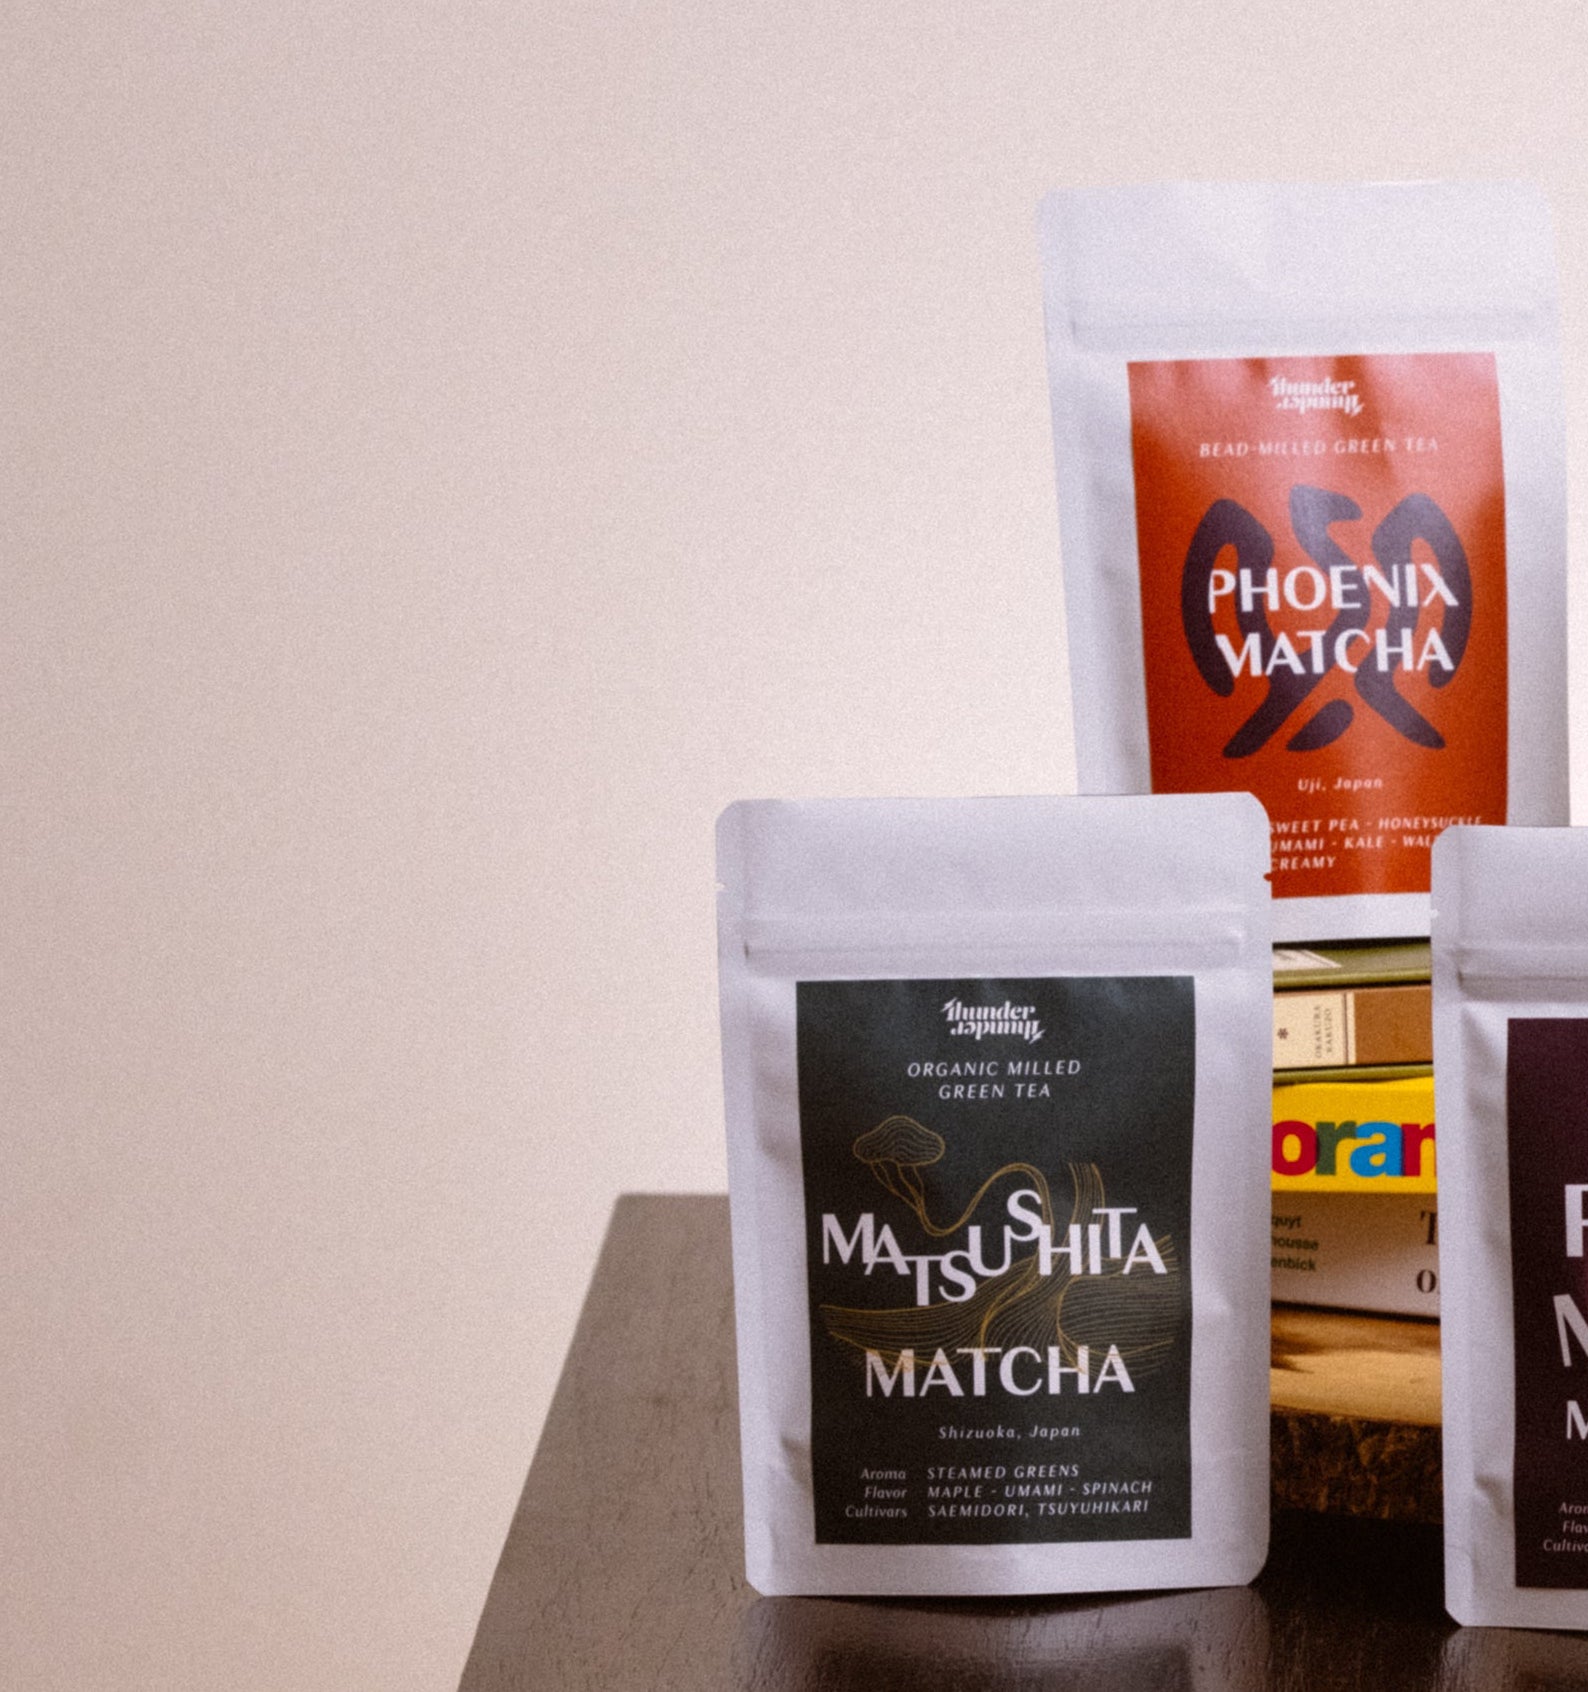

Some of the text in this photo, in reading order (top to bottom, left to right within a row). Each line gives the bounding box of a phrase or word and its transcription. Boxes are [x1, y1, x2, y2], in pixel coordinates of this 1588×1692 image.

[1200, 436, 1440, 458] BEAD-MILLED GREEN TEA
[1207, 563, 1460, 614] PHOENIX
[1214, 627, 1455, 678] MATCHA
[1333, 776, 1384, 792] Japan
[1328, 817, 1360, 832] PEA
[1343, 835, 1384, 850] KALE
[907, 1059, 1082, 1078] ORGANIC MILLED
[938, 1083, 1052, 1100] GREEN TEA
[821, 1188, 1168, 1307] MATSUSHITA
[864, 1345, 1136, 1398] MATCHA
[938, 1425, 1081, 1441] Shizuoka, Japan
[860, 1464, 1080, 1480] Aroma STEAMED GREENS
[864, 1485, 908, 1499] Flavor
[926, 1485, 984, 1499] MAPLE
[1004, 1484, 1063, 1498] UMAMI
[1081, 1481, 1152, 1496] SPINACH
[845, 1499, 1149, 1519] Cultivars SAEMIDORI, TSUYUHIKARI
